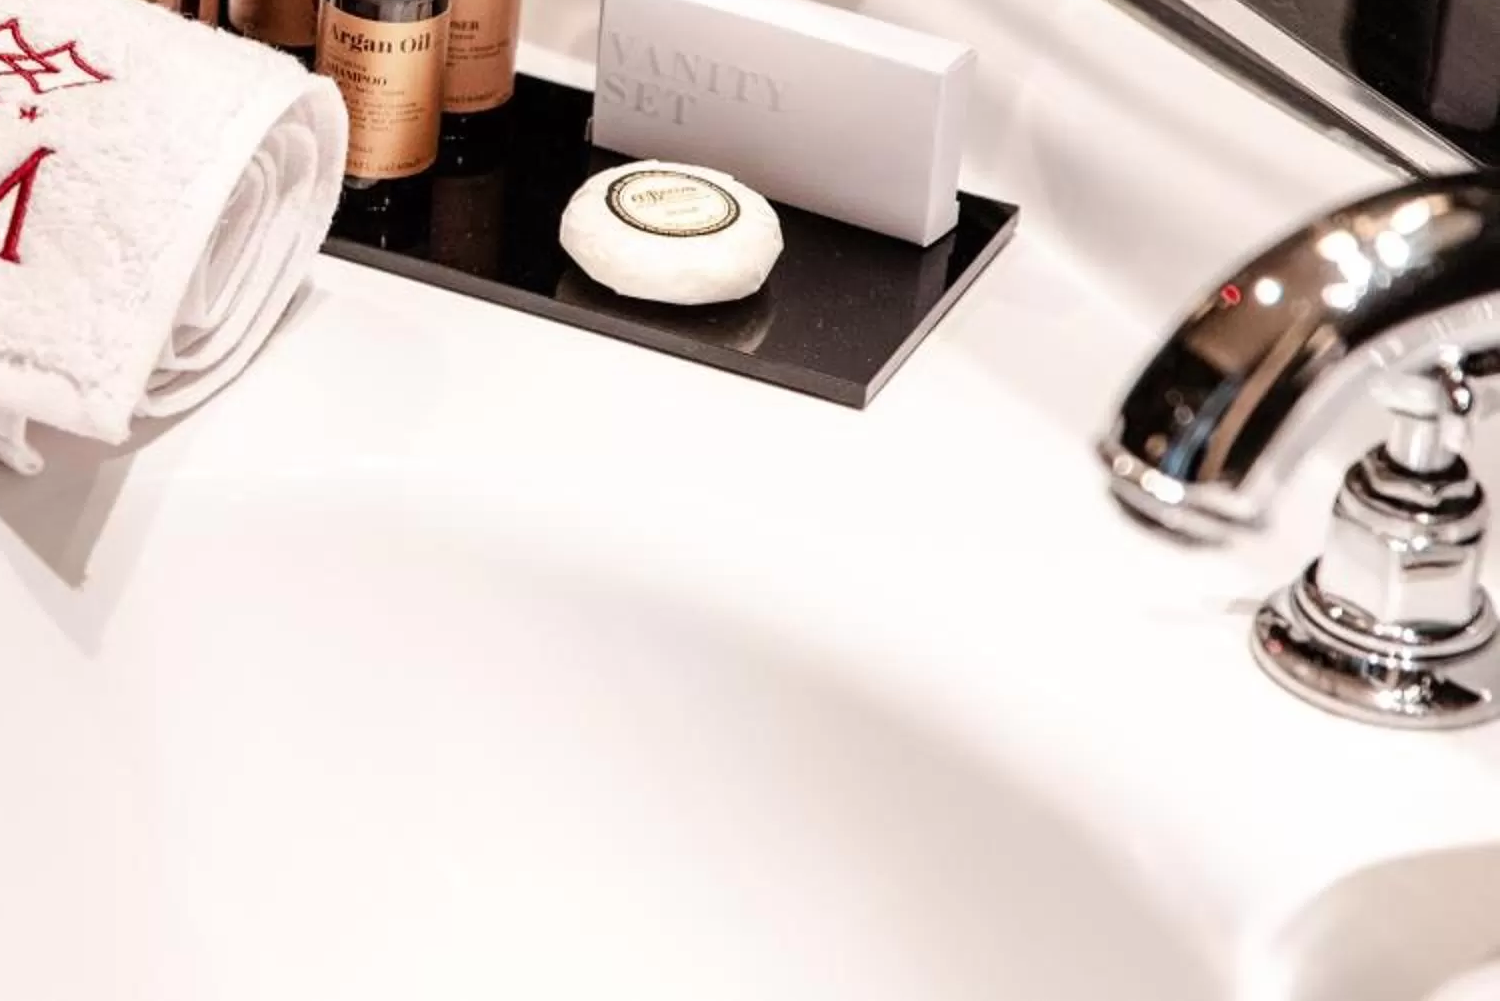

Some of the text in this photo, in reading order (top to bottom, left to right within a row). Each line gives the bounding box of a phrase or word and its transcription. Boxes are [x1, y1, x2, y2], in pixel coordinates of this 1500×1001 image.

[329, 22, 393, 54] Argan
[400, 31, 432, 53] Oil
[607, 30, 790, 113] VANITY
[602, 72, 698, 125] SET
